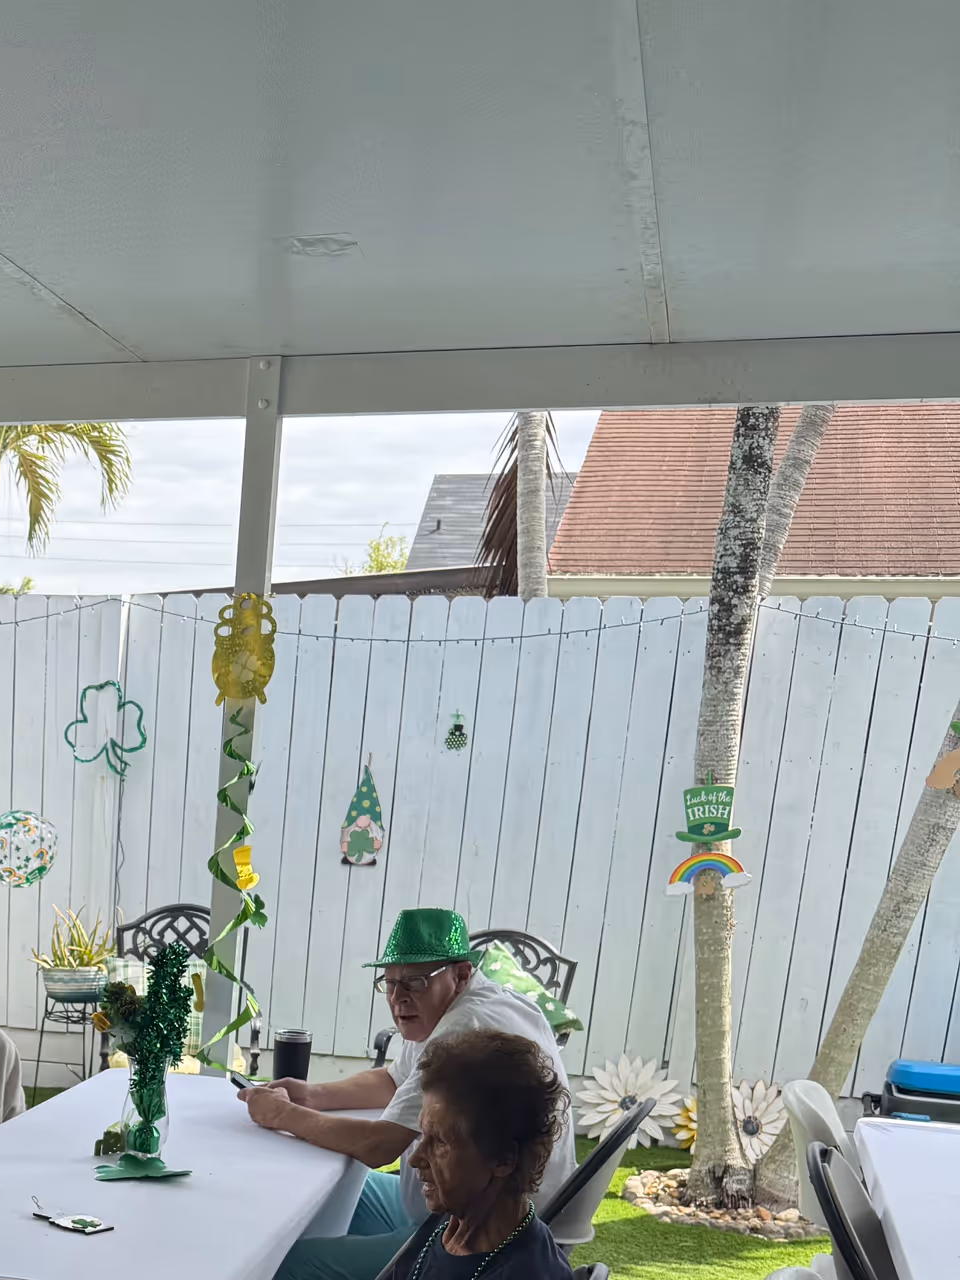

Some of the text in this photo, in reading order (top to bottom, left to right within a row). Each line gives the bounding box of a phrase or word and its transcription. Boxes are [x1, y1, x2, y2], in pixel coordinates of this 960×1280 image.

[686, 791, 731, 805] Luck of the
[687, 805, 730, 820] IRISH
